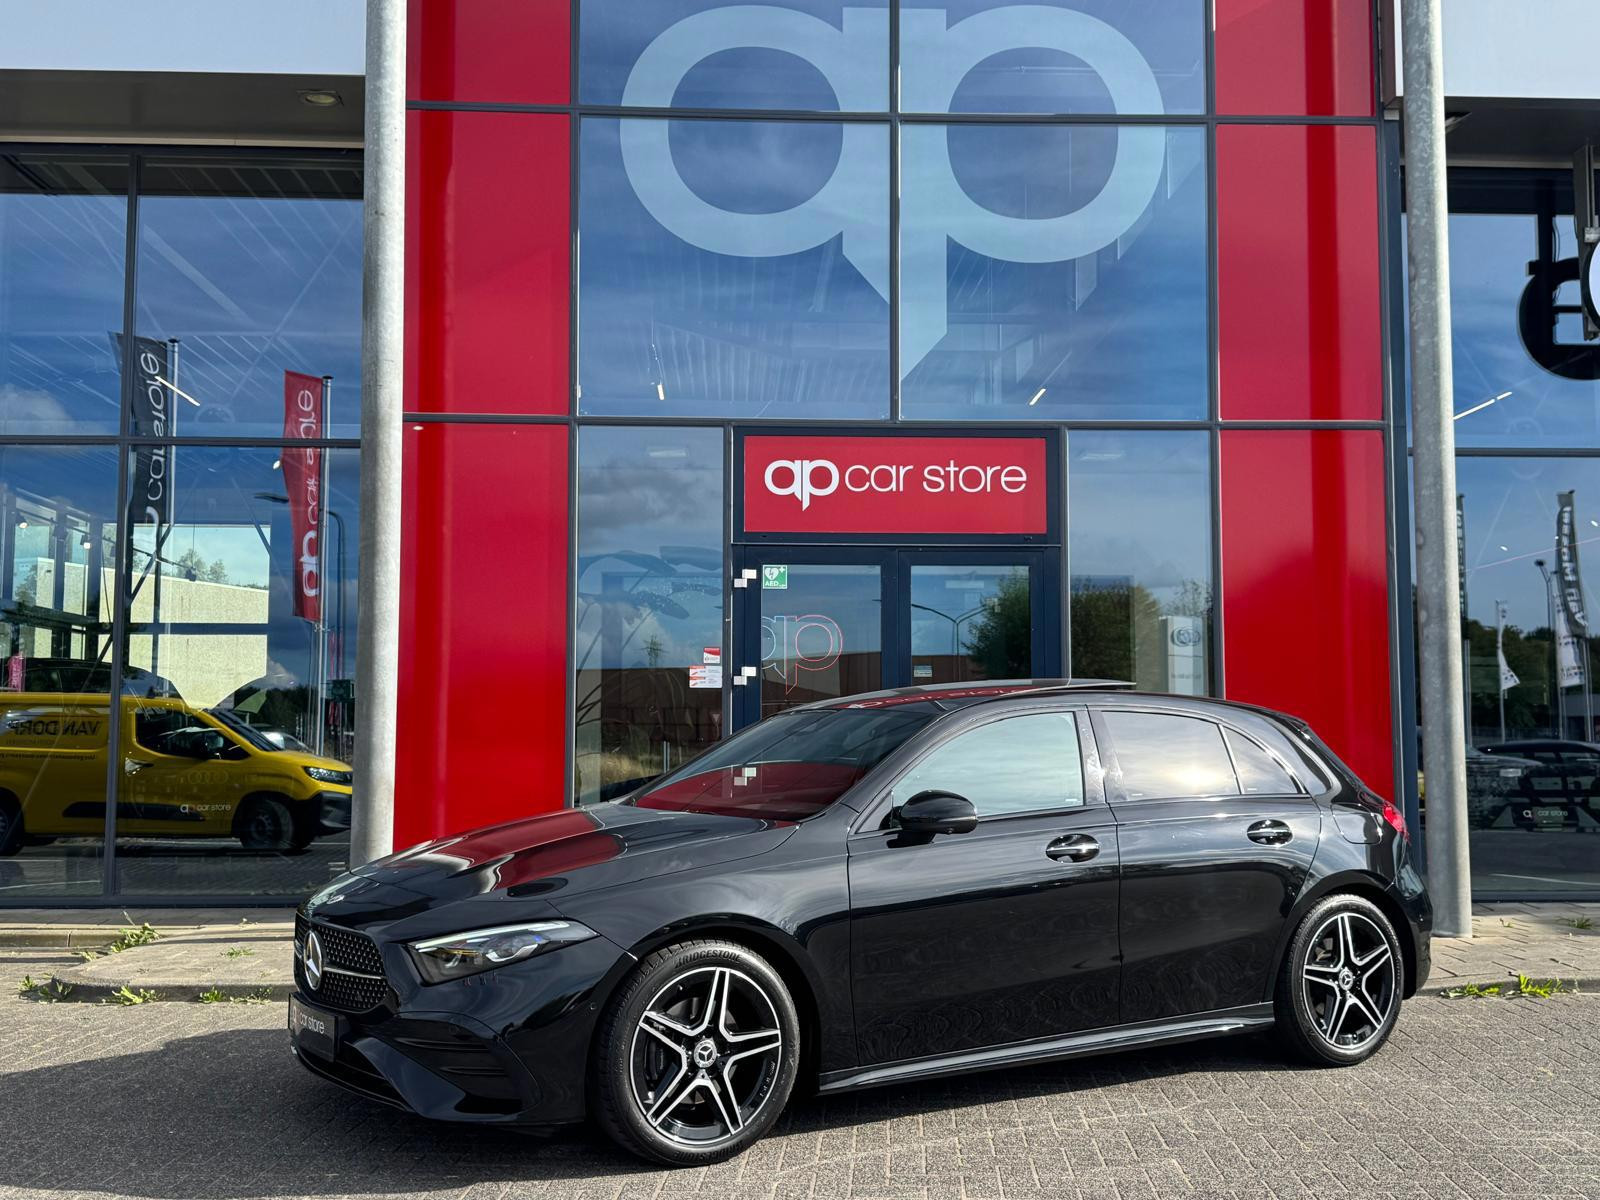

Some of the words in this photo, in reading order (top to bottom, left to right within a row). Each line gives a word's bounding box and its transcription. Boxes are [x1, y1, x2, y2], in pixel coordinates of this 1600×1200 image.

[620, 5, 1166, 380] ap
[764, 459, 840, 512] ap
[845, 465, 914, 492] car
[922, 460, 1027, 493] store
[308, 1015, 325, 1035] store
